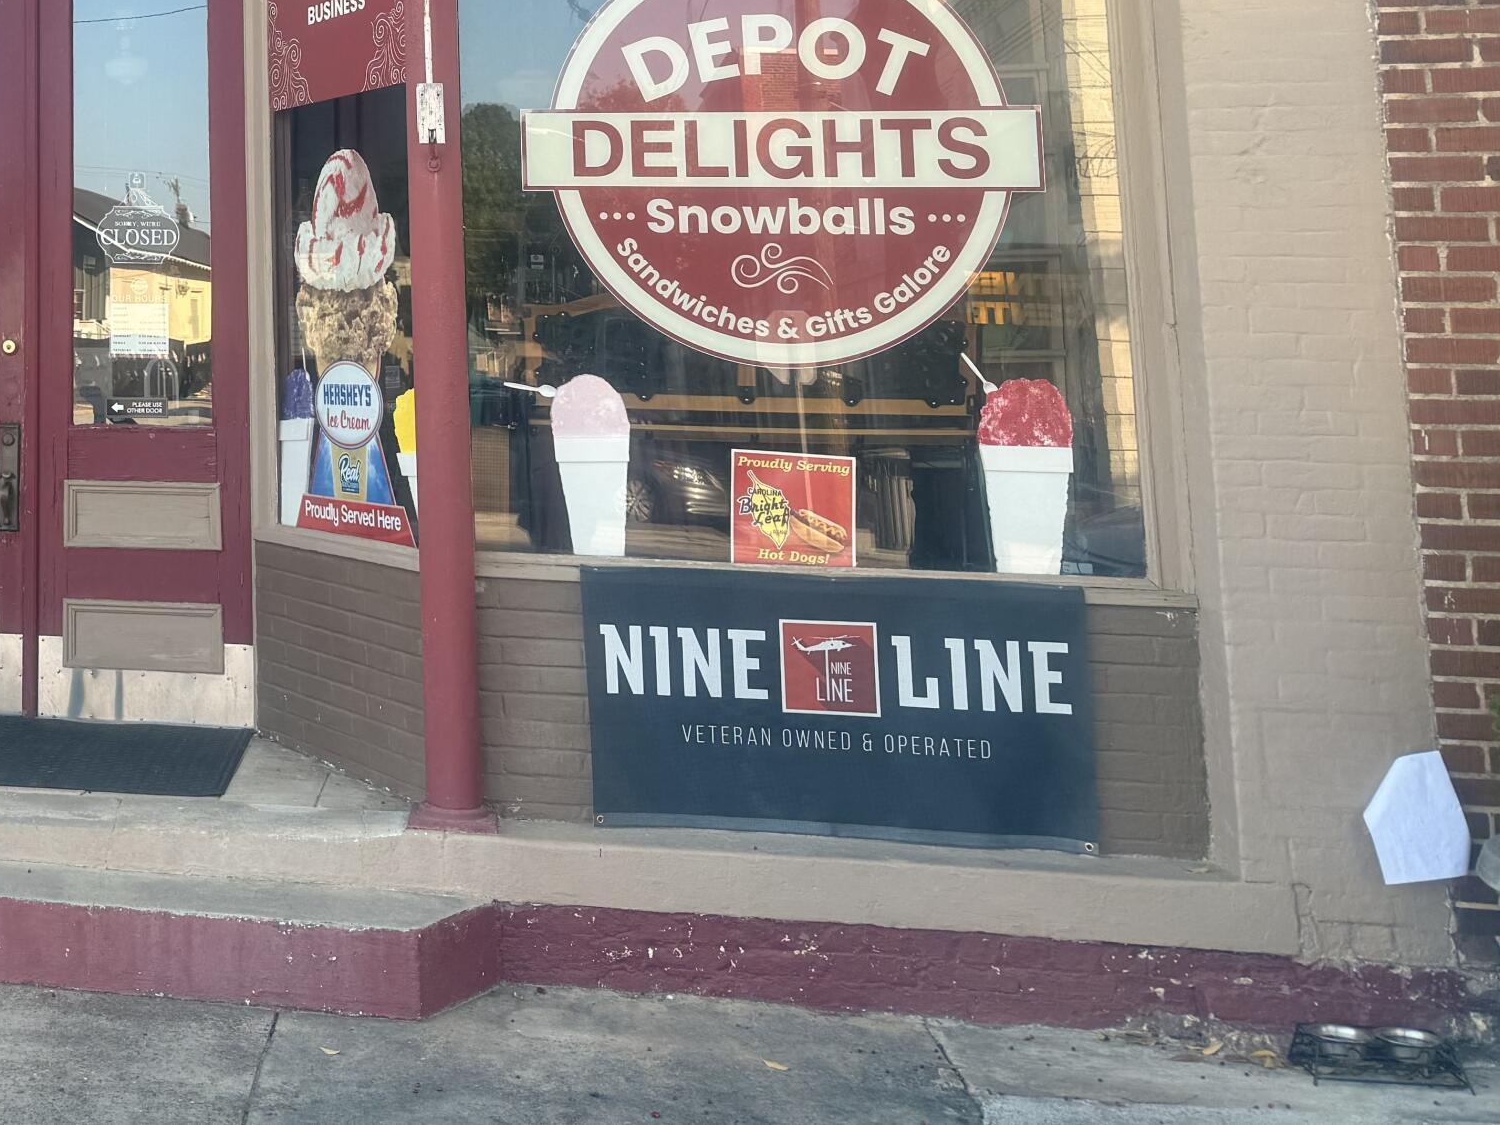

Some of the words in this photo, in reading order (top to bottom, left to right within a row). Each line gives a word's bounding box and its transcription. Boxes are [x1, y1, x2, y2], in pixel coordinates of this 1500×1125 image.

[620, 13, 931, 103] DEPOT
[570, 116, 991, 180] DELIGHTS
[646, 197, 916, 235] Snowballs
[100, 228, 177, 246] CLOSED
[617, 237, 771, 338] Sandwiches
[778, 317, 800, 340] &
[805, 303, 873, 337] Gifts
[873, 244, 952, 314] Galore
[323, 383, 372, 407] HERSHEY'S
[326, 408, 339, 428] Ice
[340, 409, 371, 430] Cream
[738, 456, 792, 472] Proudly
[796, 460, 851, 476] Serving
[748, 487, 782, 496] CAROLINA
[304, 499, 339, 526] Proudly
[341, 503, 376, 526] Served
[377, 511, 402, 531] Here
[738, 496, 788, 515] Bright
[752, 506, 790, 527] Leaf
[757, 548, 786, 561] Hot
[789, 550, 830, 565] Dogs!
[599, 623, 769, 700] NINE
[891, 635, 1073, 715] LINE
[830, 661, 852, 676] NINE
[815, 676, 854, 703] LINE
[681, 724, 772, 747] VETERAN
[782, 728, 851, 751] OWNED
[862, 732, 873, 752] &
[884, 733, 991, 760] OPERATED
